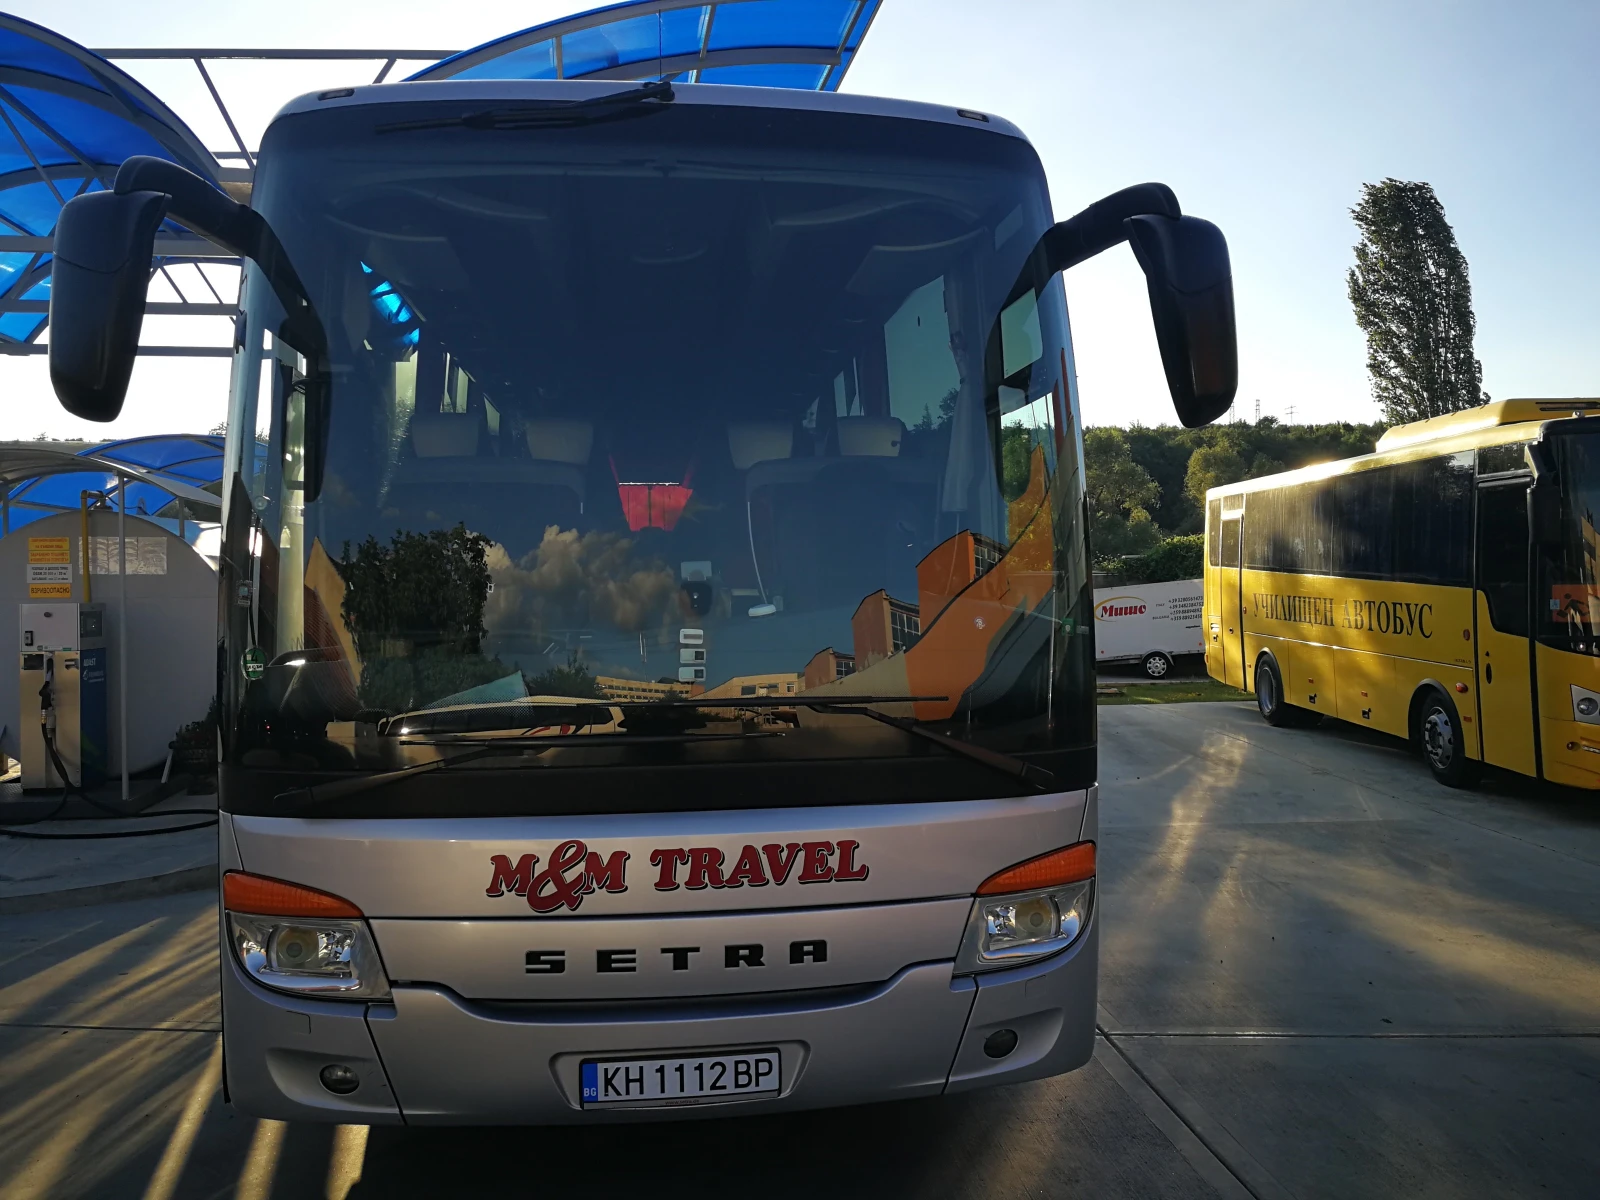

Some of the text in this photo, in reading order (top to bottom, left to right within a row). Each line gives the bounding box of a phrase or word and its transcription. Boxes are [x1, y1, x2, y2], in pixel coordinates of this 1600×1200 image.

[1253, 593, 1433, 638] УЧИЛИЩЕН АВТОБУС
[485, 839, 870, 913] M&M TRAVEL
[525, 939, 828, 974] SETRA
[583, 1087, 597, 1097] BG
